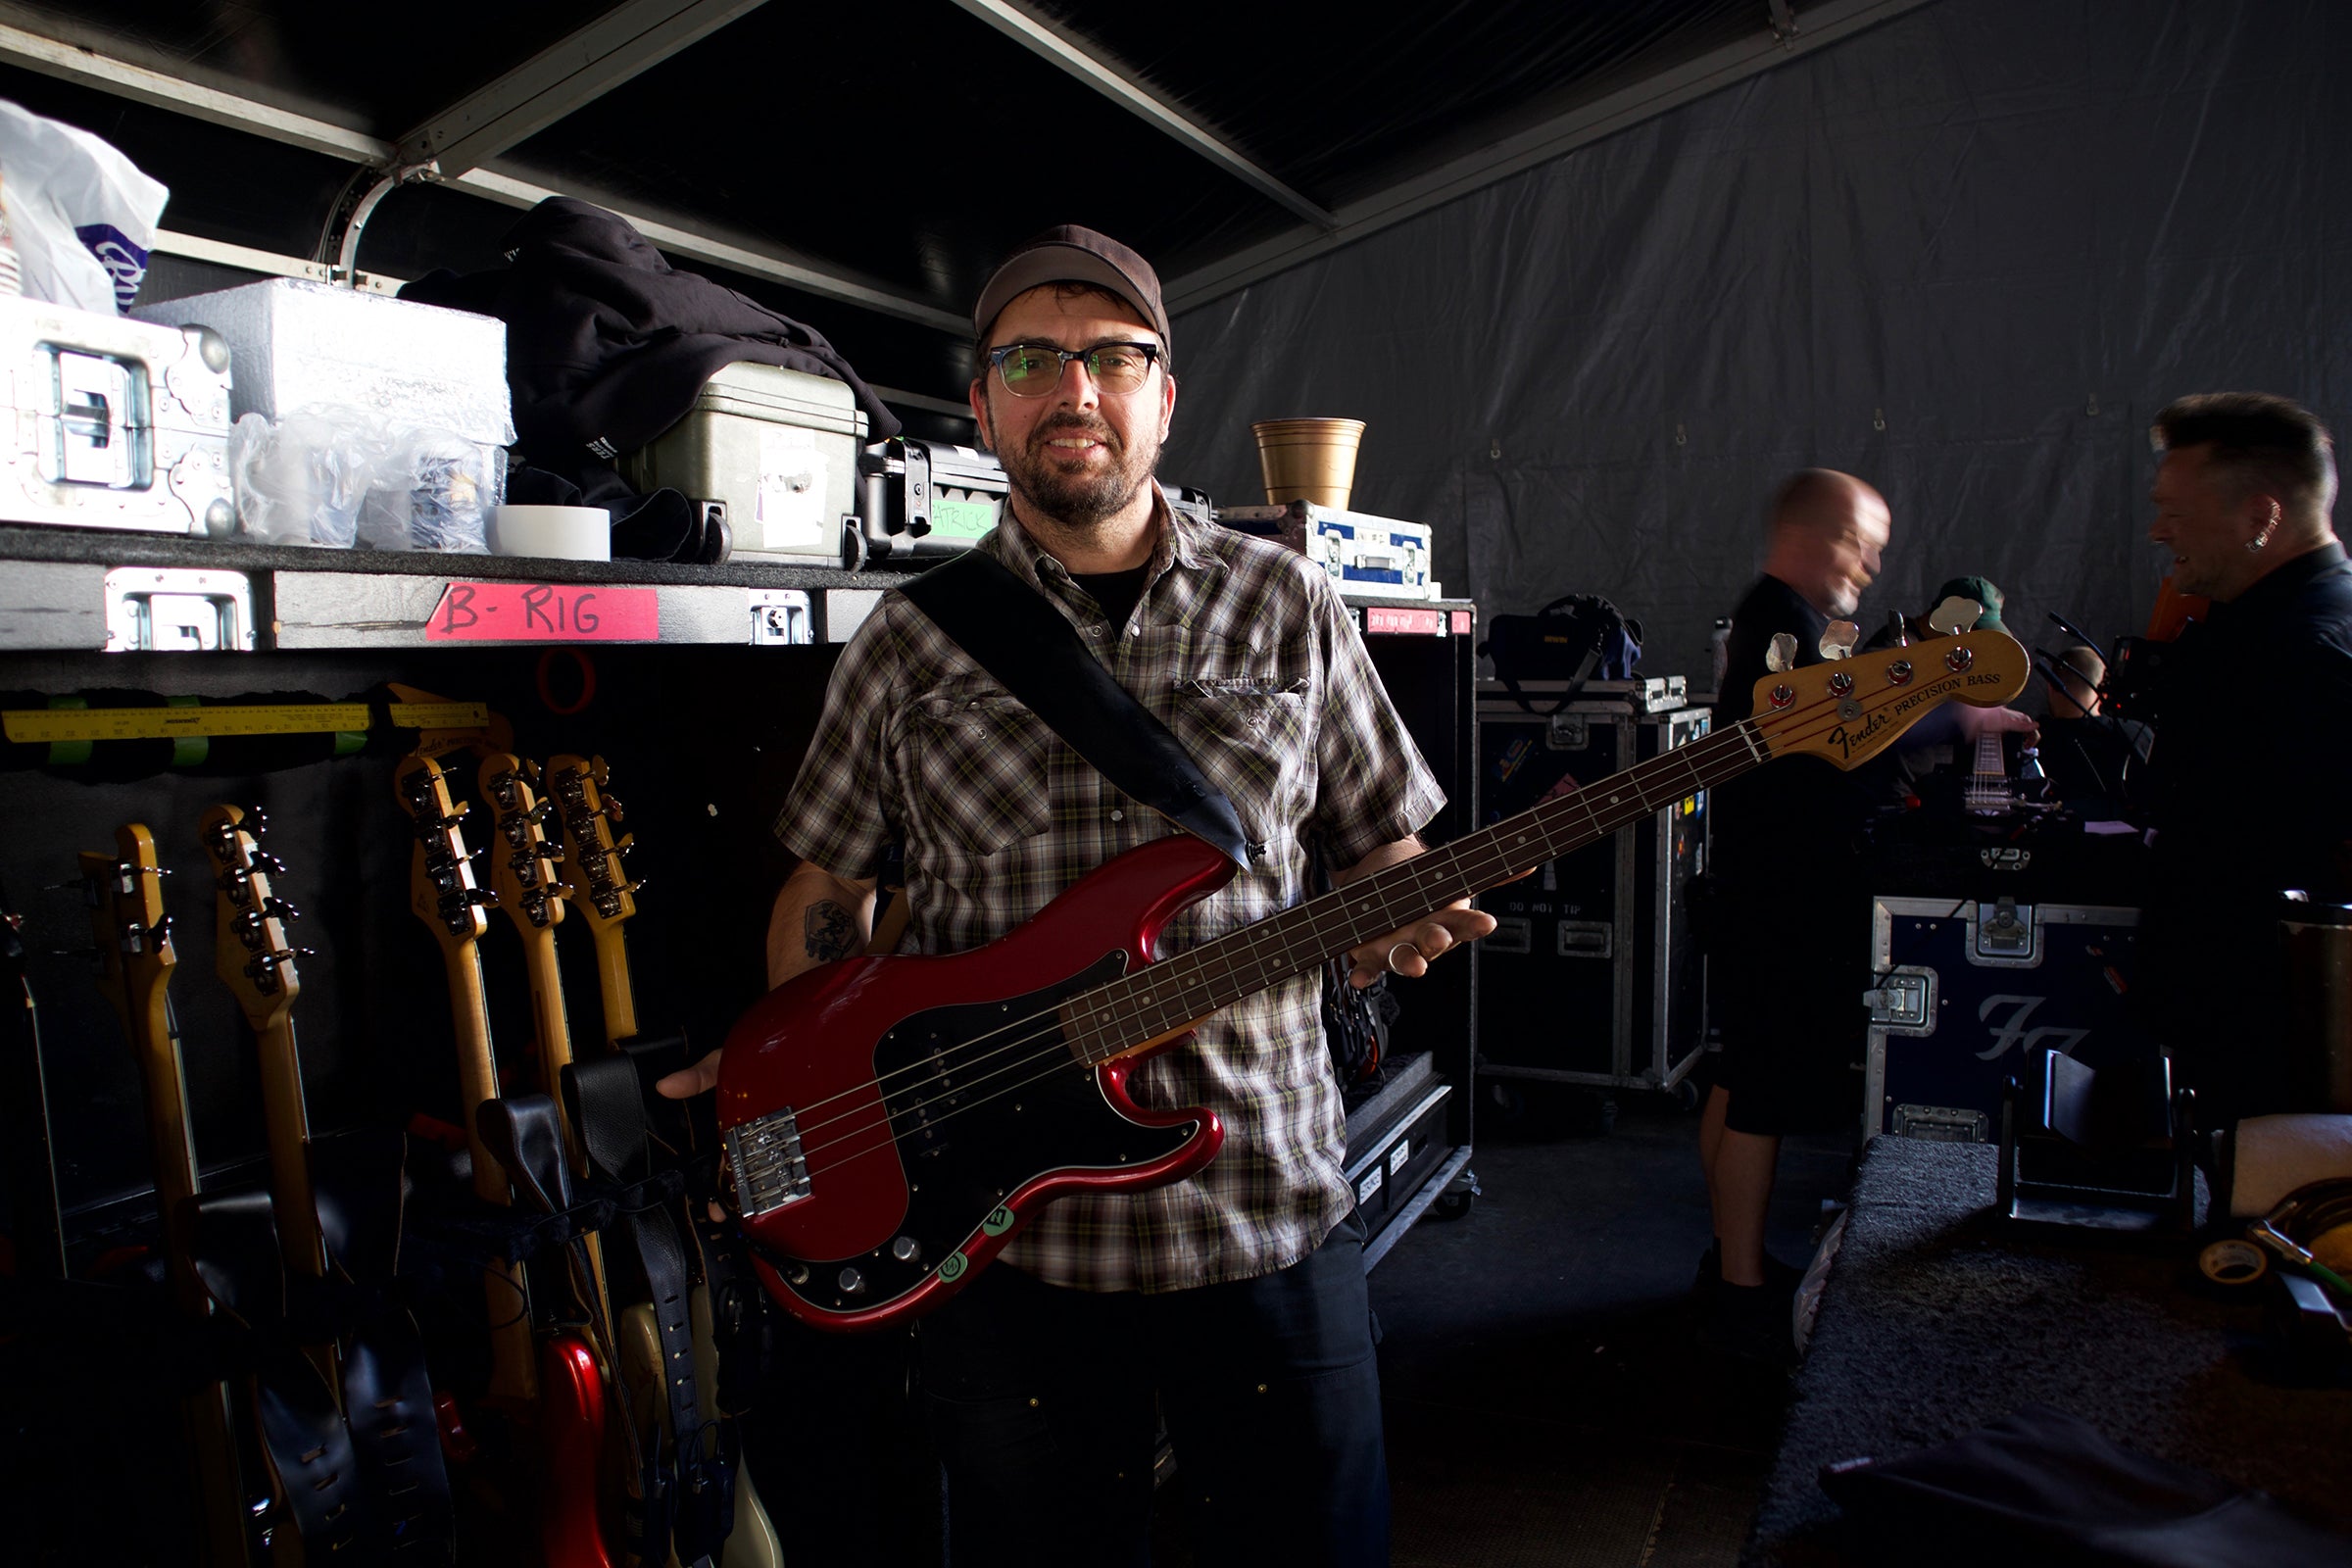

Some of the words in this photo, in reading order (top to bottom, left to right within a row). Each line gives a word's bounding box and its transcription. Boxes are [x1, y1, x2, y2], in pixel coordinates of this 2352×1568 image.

[932, 504, 989, 532] ATRICK
[520, 585, 600, 634] RIG
[1894, 678, 1961, 716] PRECISION
[1966, 673, 2001, 687] BASS
[1828, 713, 1891, 760] Fender
